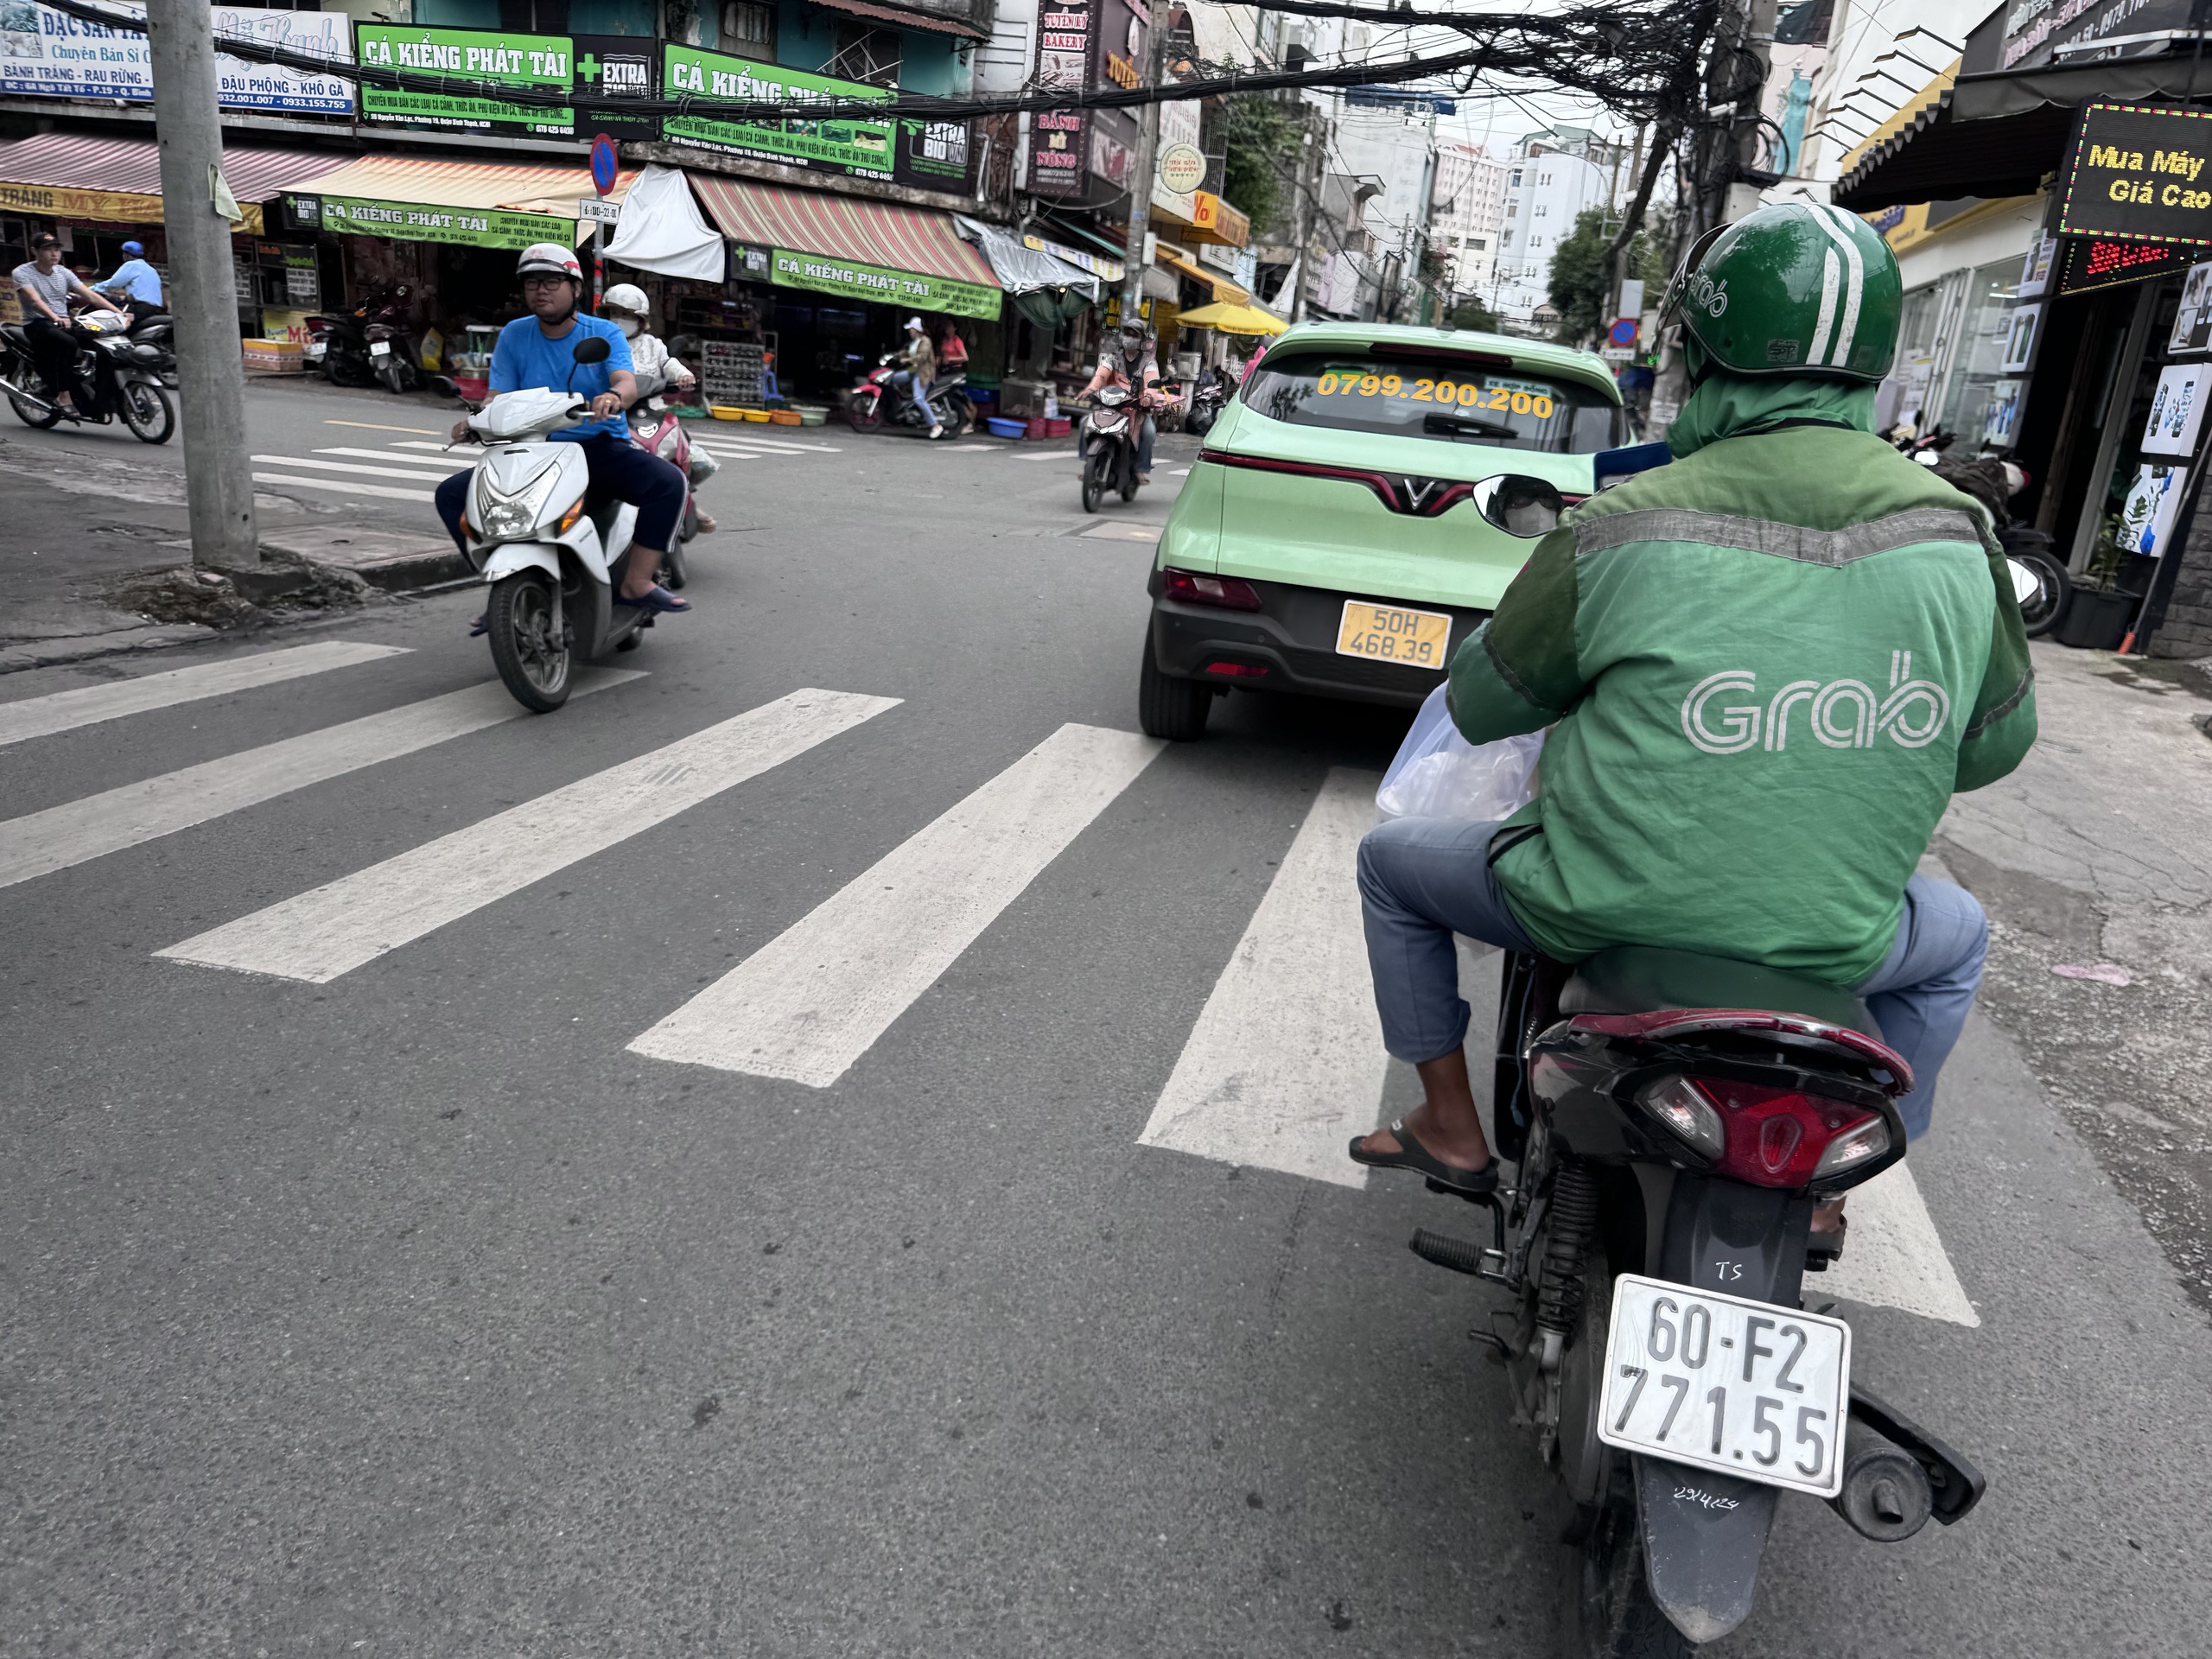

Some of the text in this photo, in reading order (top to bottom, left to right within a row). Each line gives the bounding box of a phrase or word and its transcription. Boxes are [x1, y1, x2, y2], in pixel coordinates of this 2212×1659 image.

[52, 44, 96, 62] Chuyên
[100, 47, 124, 61] Bán
[365, 32, 567, 77] CÁ KIỂNG PHÁT TÀI
[1043, 33, 1087, 50] BAKERY
[3, 62, 33, 79] BÁNH
[37, 64, 74, 80] TRÁNG
[85, 69, 107, 82] RAU
[111, 67, 141, 84] RỪNG
[221, 74, 245, 94] ĐẬU
[249, 77, 289, 96] PHỘNG
[301, 80, 324, 96] KHÔ
[329, 81, 344, 96] GÀ
[603, 62, 647, 84] EXTRA
[673, 60, 705, 92] CÁ
[219, 94, 274, 105] 932.001.007
[283, 98, 346, 109] 0933.155.755
[1038, 111, 1080, 131] BÁNH
[924, 138, 946, 160] BIO
[1036, 149, 1077, 168] NÓNG
[2088, 144, 2205, 181] Mua Máy
[2109, 180, 2212, 209] Giá Cao
[325, 201, 347, 219] CÁ
[405, 209, 454, 228] PHÁT
[457, 212, 488, 232] TÀI
[778, 257, 801, 274] CÁ
[856, 273, 899, 291] PHÁT
[903, 278, 931, 296] TÀI
[1317, 373, 1554, 419] 0799.200.200
[1372, 609, 1420, 637] 50H
[1350, 632, 1433, 664] 468.39
[1681, 650, 1950, 754] Grab
[1715, 1262, 1743, 1281] TS
[1647, 1296, 1808, 1394] 60-F2
[1614, 1363, 1827, 1478] 771.55
